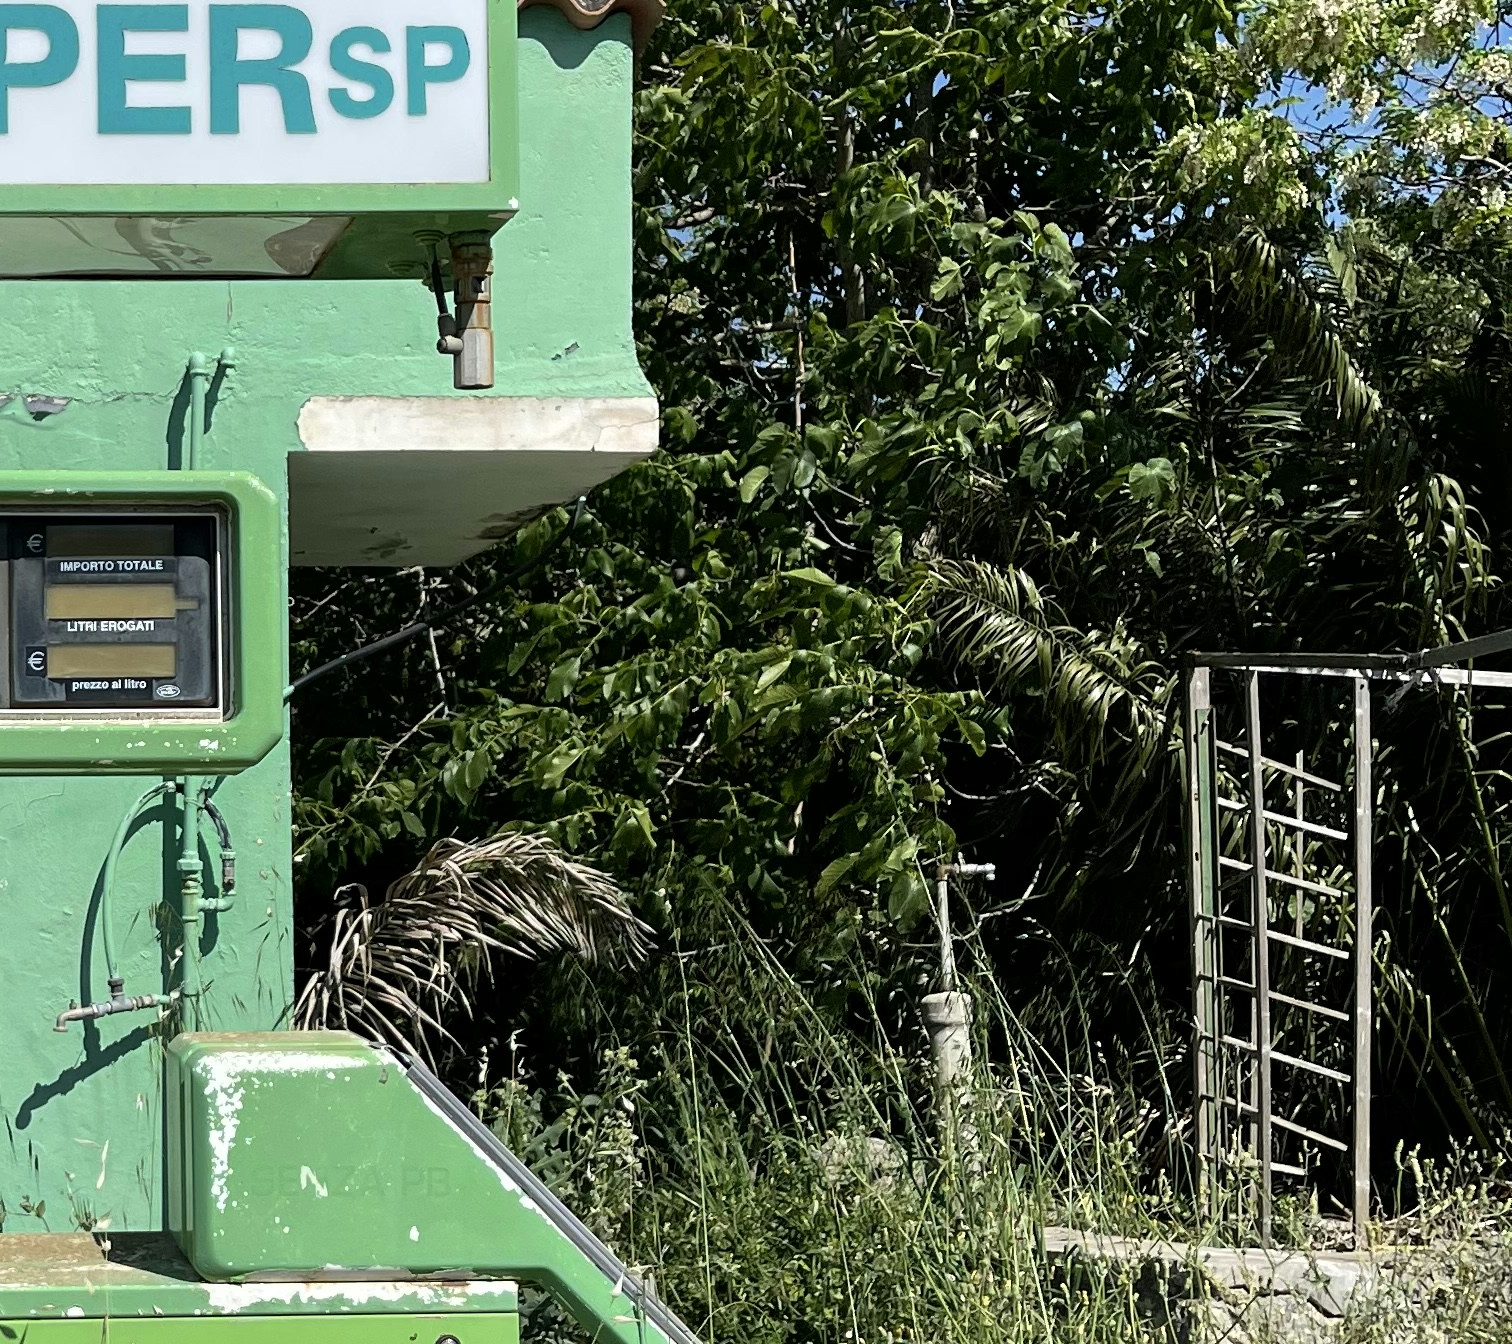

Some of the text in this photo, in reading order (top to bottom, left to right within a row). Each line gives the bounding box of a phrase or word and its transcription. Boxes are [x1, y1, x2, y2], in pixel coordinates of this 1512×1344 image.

[59, 559, 164, 572] IMPORTO TOTALE
[67, 620, 155, 632] LITRI EROGATI
[72, 678, 147, 692] prezzo al litro
